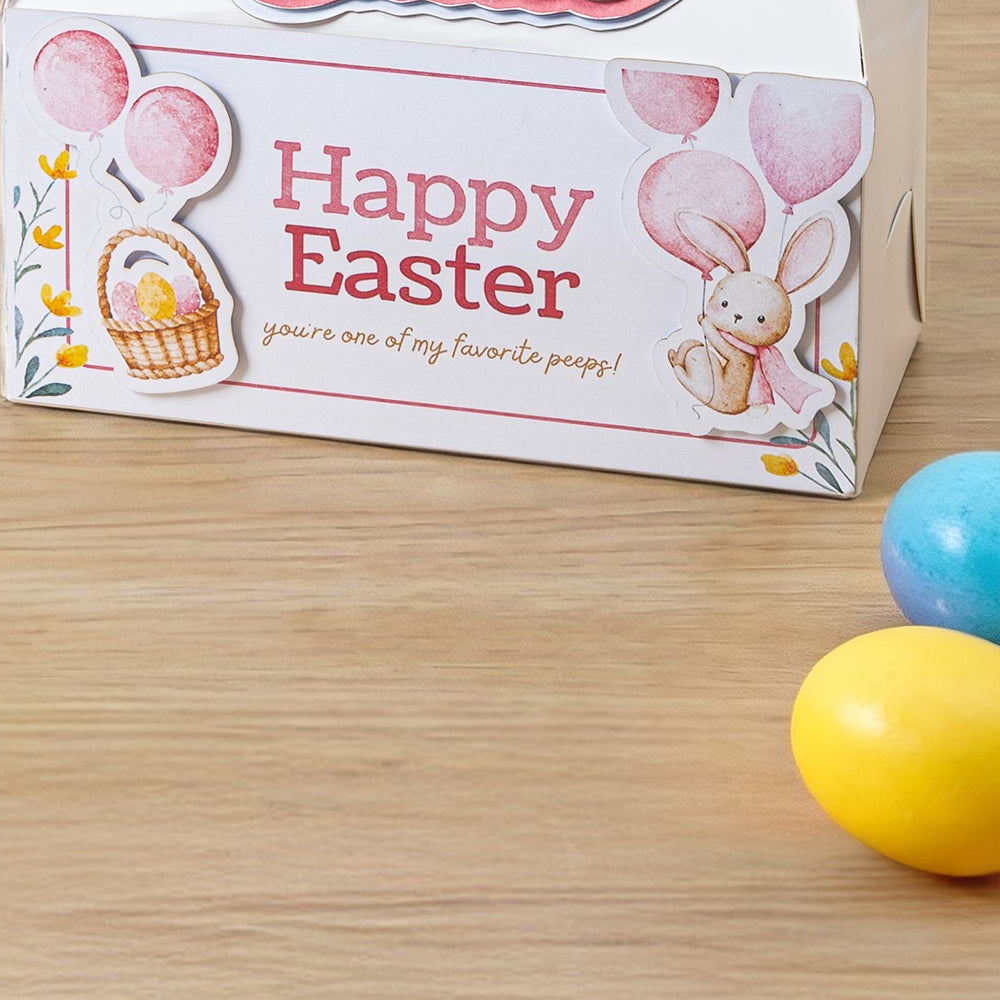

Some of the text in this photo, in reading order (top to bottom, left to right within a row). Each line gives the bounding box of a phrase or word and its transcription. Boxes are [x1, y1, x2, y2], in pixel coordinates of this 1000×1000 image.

[273, 140, 594, 251] Happy
[285, 224, 580, 319] Easter
[262, 321, 622, 378] you're one of my favorite peeps!
